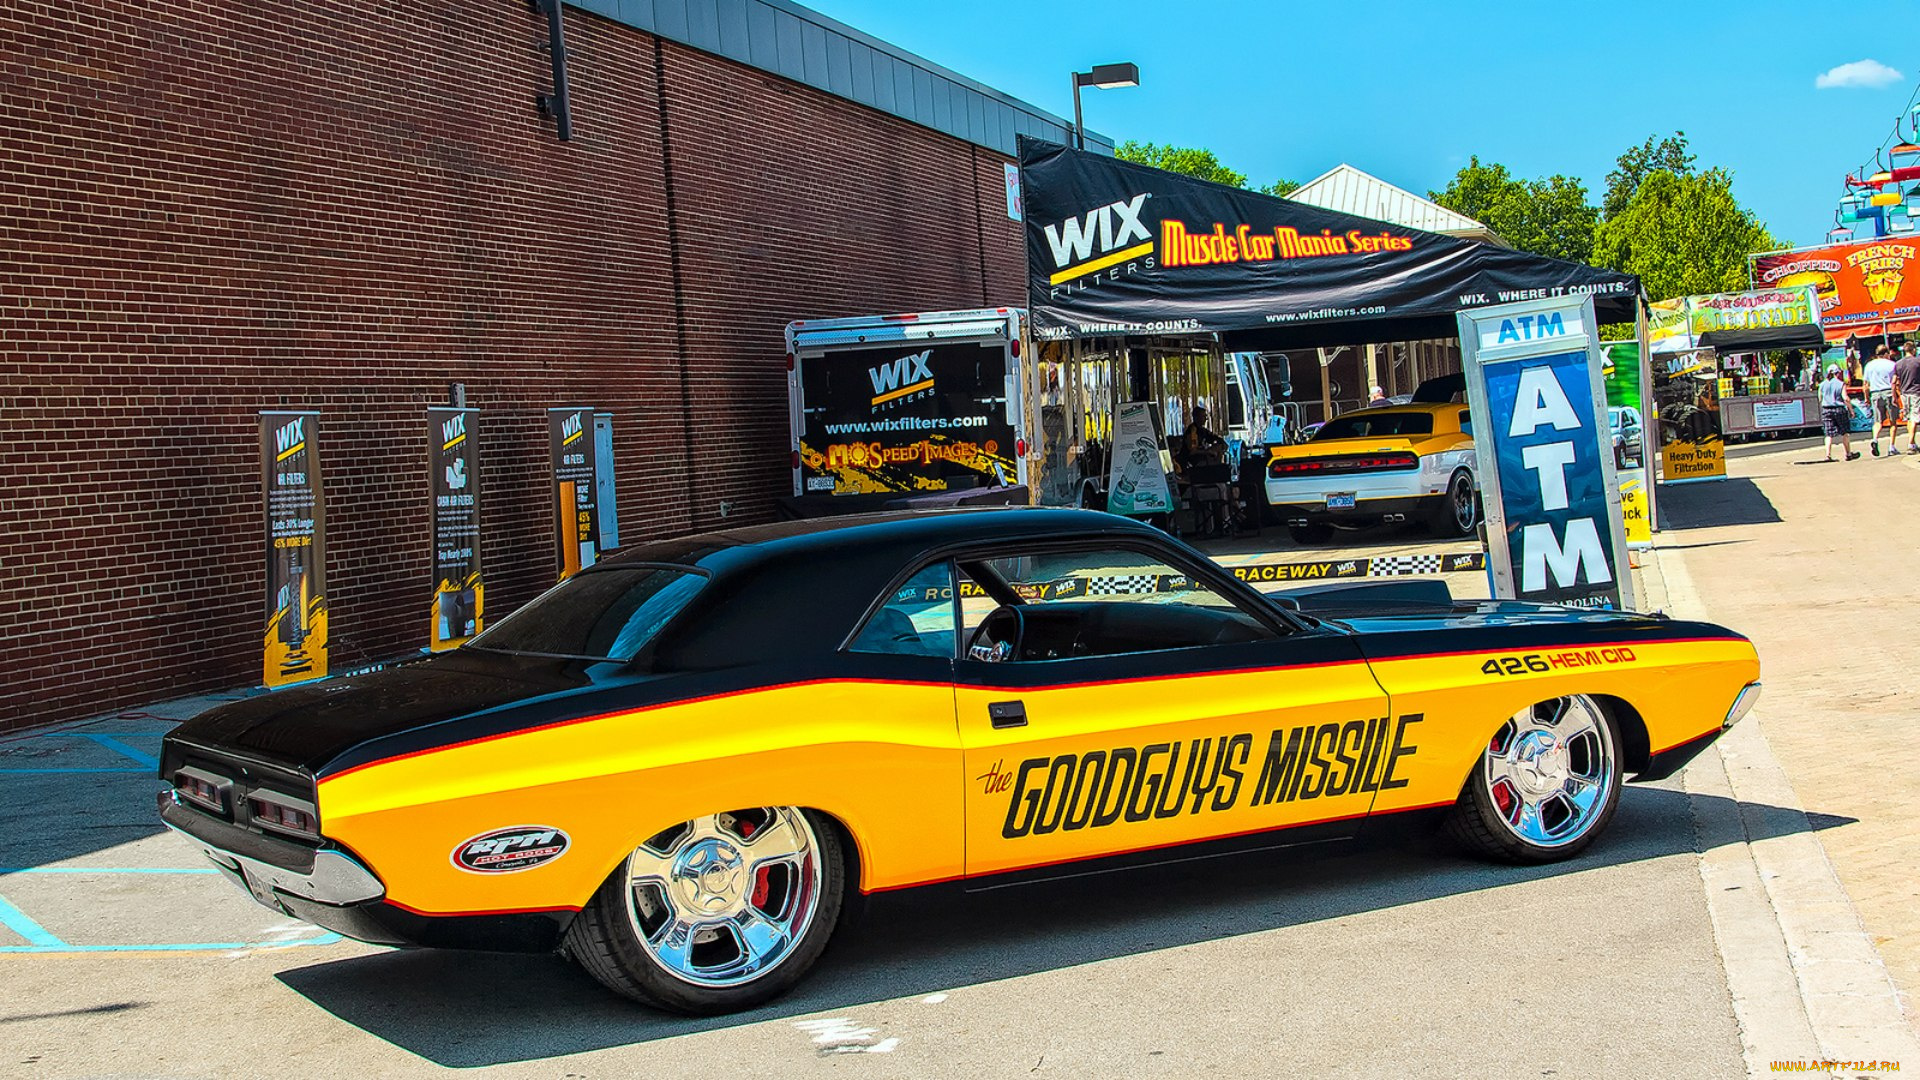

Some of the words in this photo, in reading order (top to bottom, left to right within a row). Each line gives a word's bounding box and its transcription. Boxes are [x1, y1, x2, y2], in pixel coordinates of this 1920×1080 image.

[1044, 193, 1152, 268] WIX
[1161, 219, 1239, 268] Muscle
[1237, 223, 1276, 261] Car
[1275, 225, 1348, 259] Mania
[1346, 229, 1413, 253] Series
[1846, 244, 1916, 268] FRENCH
[1859, 257, 1905, 274] FRIES
[1051, 256, 1156, 299] FILTERS
[1763, 260, 1842, 283] CHOPPED
[1459, 293, 1490, 305] WIX.
[1498, 287, 1547, 302] WHERE
[1551, 286, 1565, 298] IT
[1568, 281, 1629, 296] COUNTS.
[1265, 304, 1386, 322] www.wixfilters.com
[1714, 306, 1809, 331] LEMONADE
[1822, 315, 1842, 323] OLD
[1843, 311, 1879, 321] DRINKS
[1079, 322, 1126, 333] WHERE
[1128, 322, 1142, 331] IT
[1145, 318, 1203, 331] COUNTS.
[1497, 311, 1566, 344] ATM
[869, 349, 933, 395] WIX
[1666, 350, 1700, 373] WIX
[872, 388, 936, 414] FILTERS
[275, 415, 305, 453] WIX
[442, 412, 466, 443] WIX
[561, 411, 582, 439] WIX
[825, 414, 988, 435] www.wixfilters.com
[1669, 449, 1694, 462] Heavy
[1696, 448, 1717, 461] Duty
[1674, 459, 1715, 474] Filtration
[1509, 364, 1612, 593] ATM
[1234, 563, 1331, 583] RACEWAY
[1336, 561, 1356, 574] WIX
[1453, 554, 1473, 567] WIX
[898, 588, 916, 599] WIX
[1481, 654, 1550, 676] 426
[1547, 650, 1602, 669] HEMI
[1601, 647, 1637, 664] CID
[977, 759, 1013, 796] the
[1001, 732, 1254, 840] GOODGUYS
[1249, 713, 1424, 808] MISSILE
[467, 829, 559, 855] RPM
[480, 855, 510, 863] HOT
[515, 848, 553, 858] RODS
